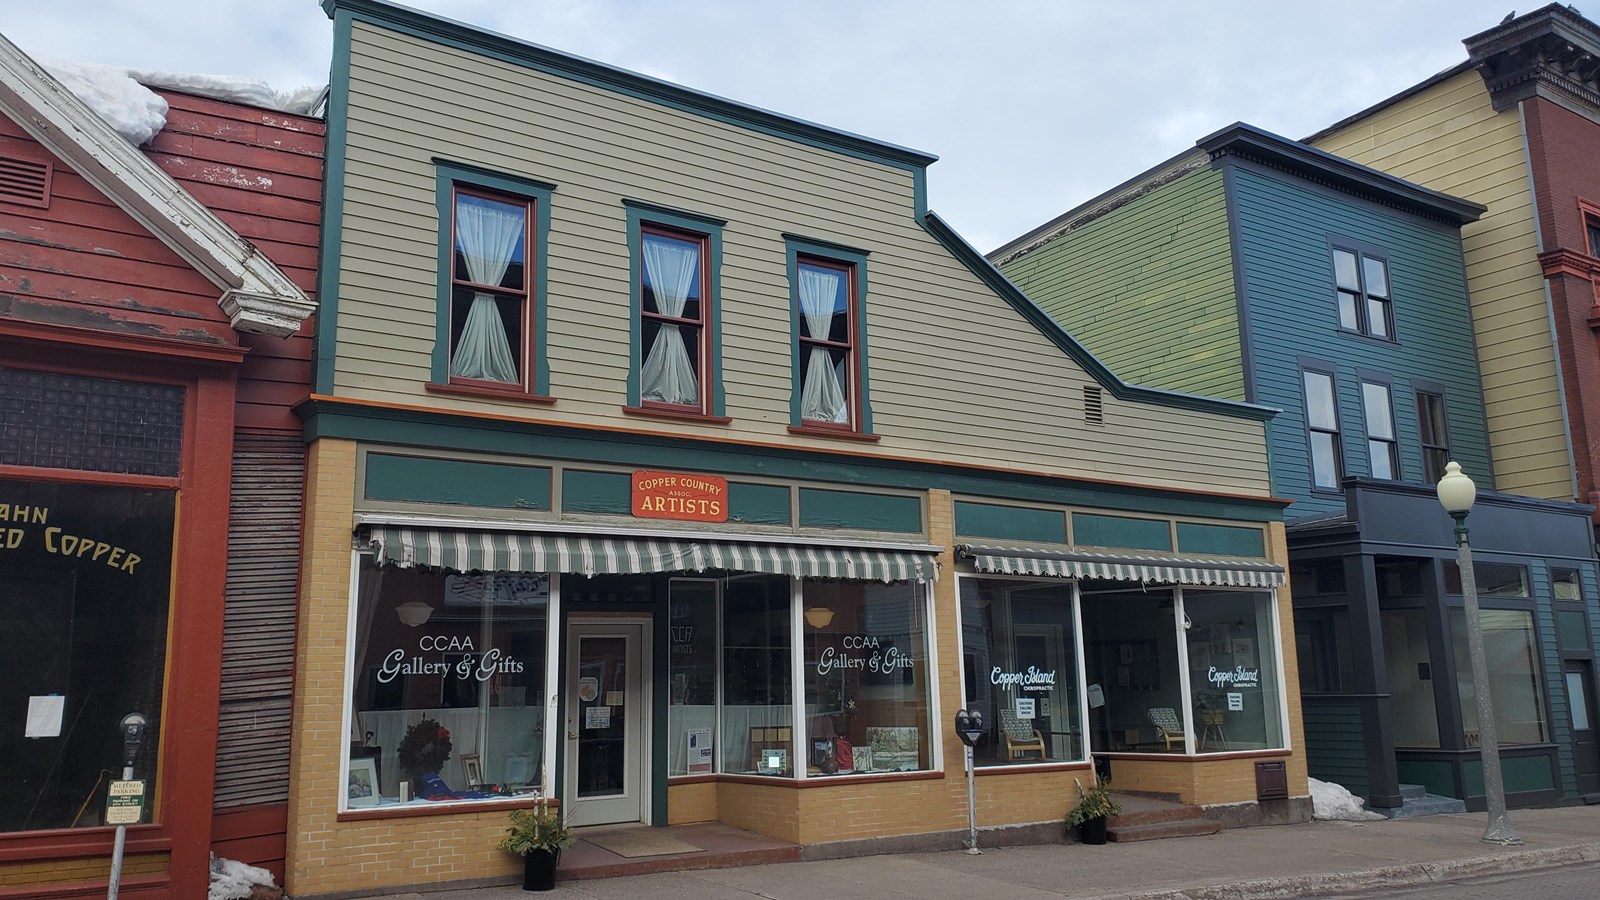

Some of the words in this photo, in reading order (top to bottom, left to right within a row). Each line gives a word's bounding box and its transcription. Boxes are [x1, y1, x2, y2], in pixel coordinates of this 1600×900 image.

[638, 477, 677, 491] COPPER
[680, 478, 722, 496] COUNTRY
[641, 496, 720, 515] ARTISTS
[419, 635, 474, 651] CCAA
[843, 636, 880, 649] CCAA
[377, 648, 452, 683] Gallery
[455, 653, 475, 680] &
[475, 648, 524, 682] Gifts
[817, 646, 866, 675] Gallery
[868, 651, 882, 673] &
[882, 646, 914, 675] Gifts
[990, 665, 1025, 691] Copper
[1024, 665, 1056, 685] Island
[1208, 665, 1234, 688] Copper
[1233, 665, 1258, 682] Island
